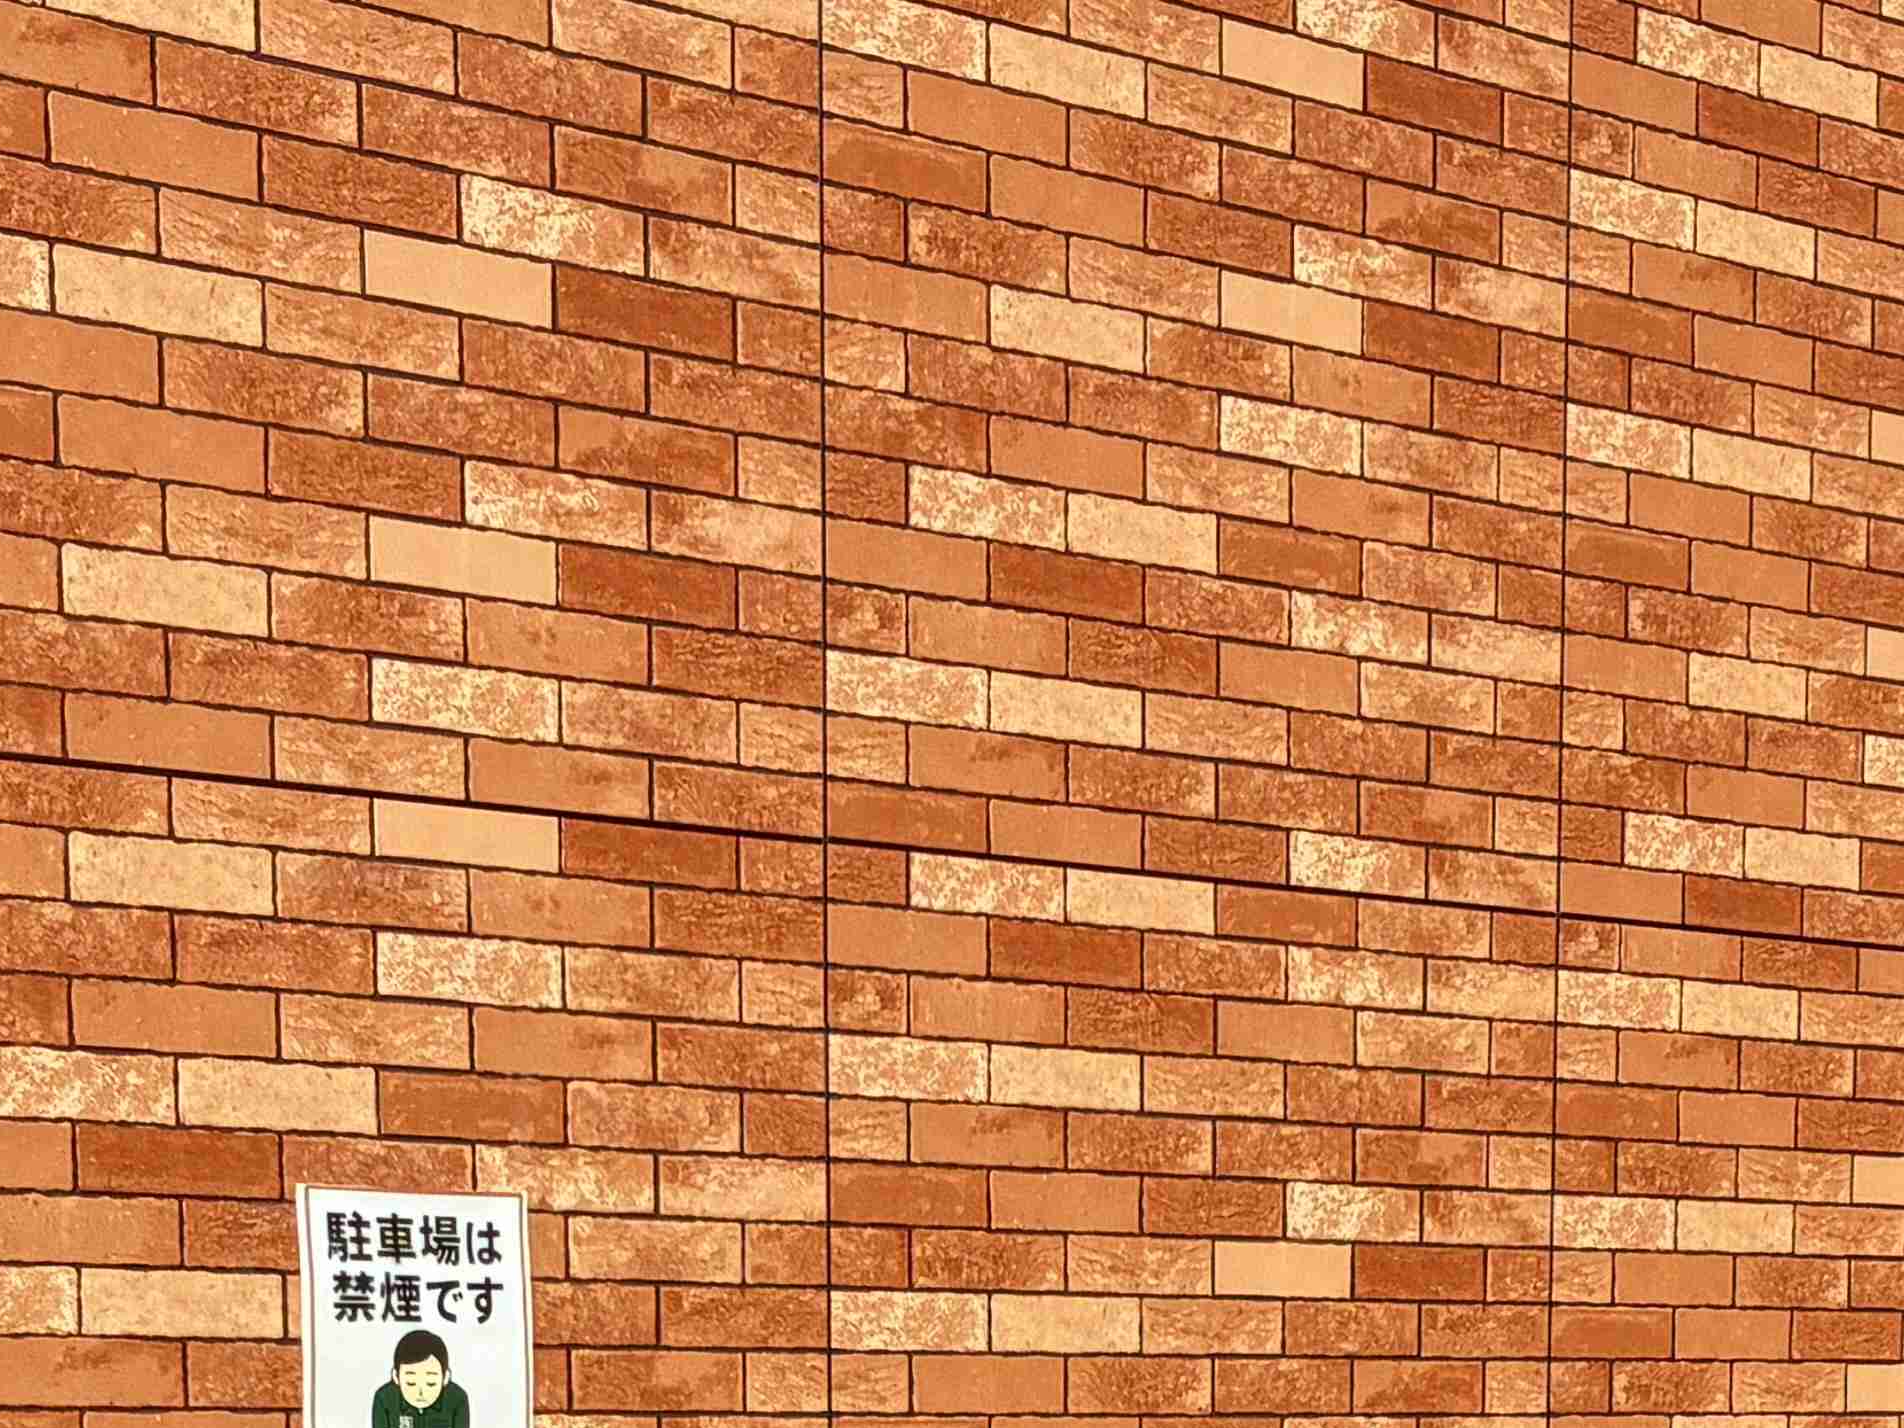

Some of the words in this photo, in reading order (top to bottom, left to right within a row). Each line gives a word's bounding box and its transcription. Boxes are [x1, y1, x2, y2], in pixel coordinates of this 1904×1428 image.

[326, 1211, 503, 1265] 駐車場は
[331, 1272, 504, 1324] 禁煙です
